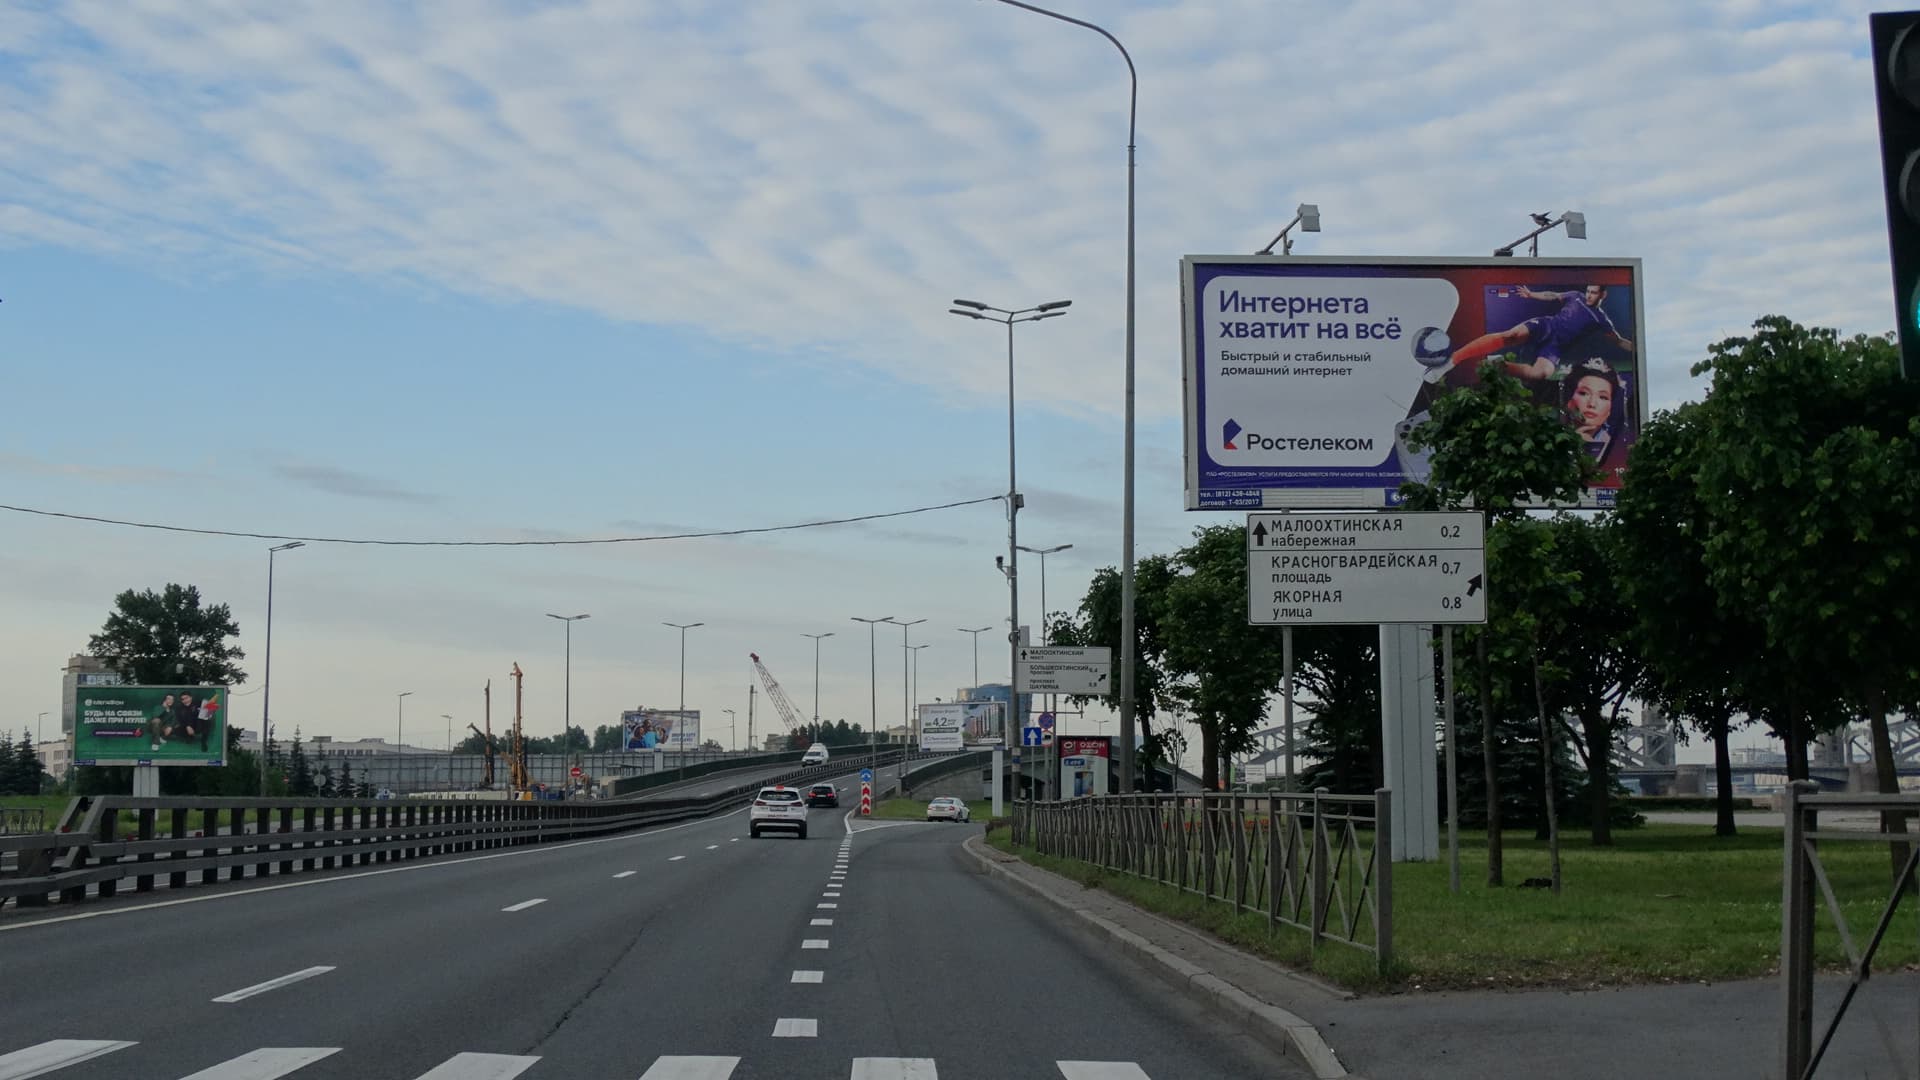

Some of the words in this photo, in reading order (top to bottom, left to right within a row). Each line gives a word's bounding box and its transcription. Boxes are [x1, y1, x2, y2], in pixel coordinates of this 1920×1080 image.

[1220, 290, 1368, 319] Интернета
[1220, 322, 1310, 339] хватит
[1317, 322, 1348, 339] на
[1356, 318, 1402, 340] всё
[1221, 350, 1280, 364] Быстрый
[1283, 352, 1290, 361] и
[1294, 351, 1372, 362] стабильный
[1221, 366, 1290, 376] домашний
[1293, 367, 1352, 377] интернет
[1247, 433, 1374, 451] Ростелеком
[1271, 519, 1402, 532] МАЛООХТИНСКАЯ
[1271, 535, 1356, 549] набережная
[1272, 553, 1438, 569] КРАСНОГВАРДЕЙСКАЯ
[1272, 573, 1332, 584] площадь
[1273, 590, 1342, 602] ЯКОРНАЯ
[1273, 607, 1312, 619] улица
